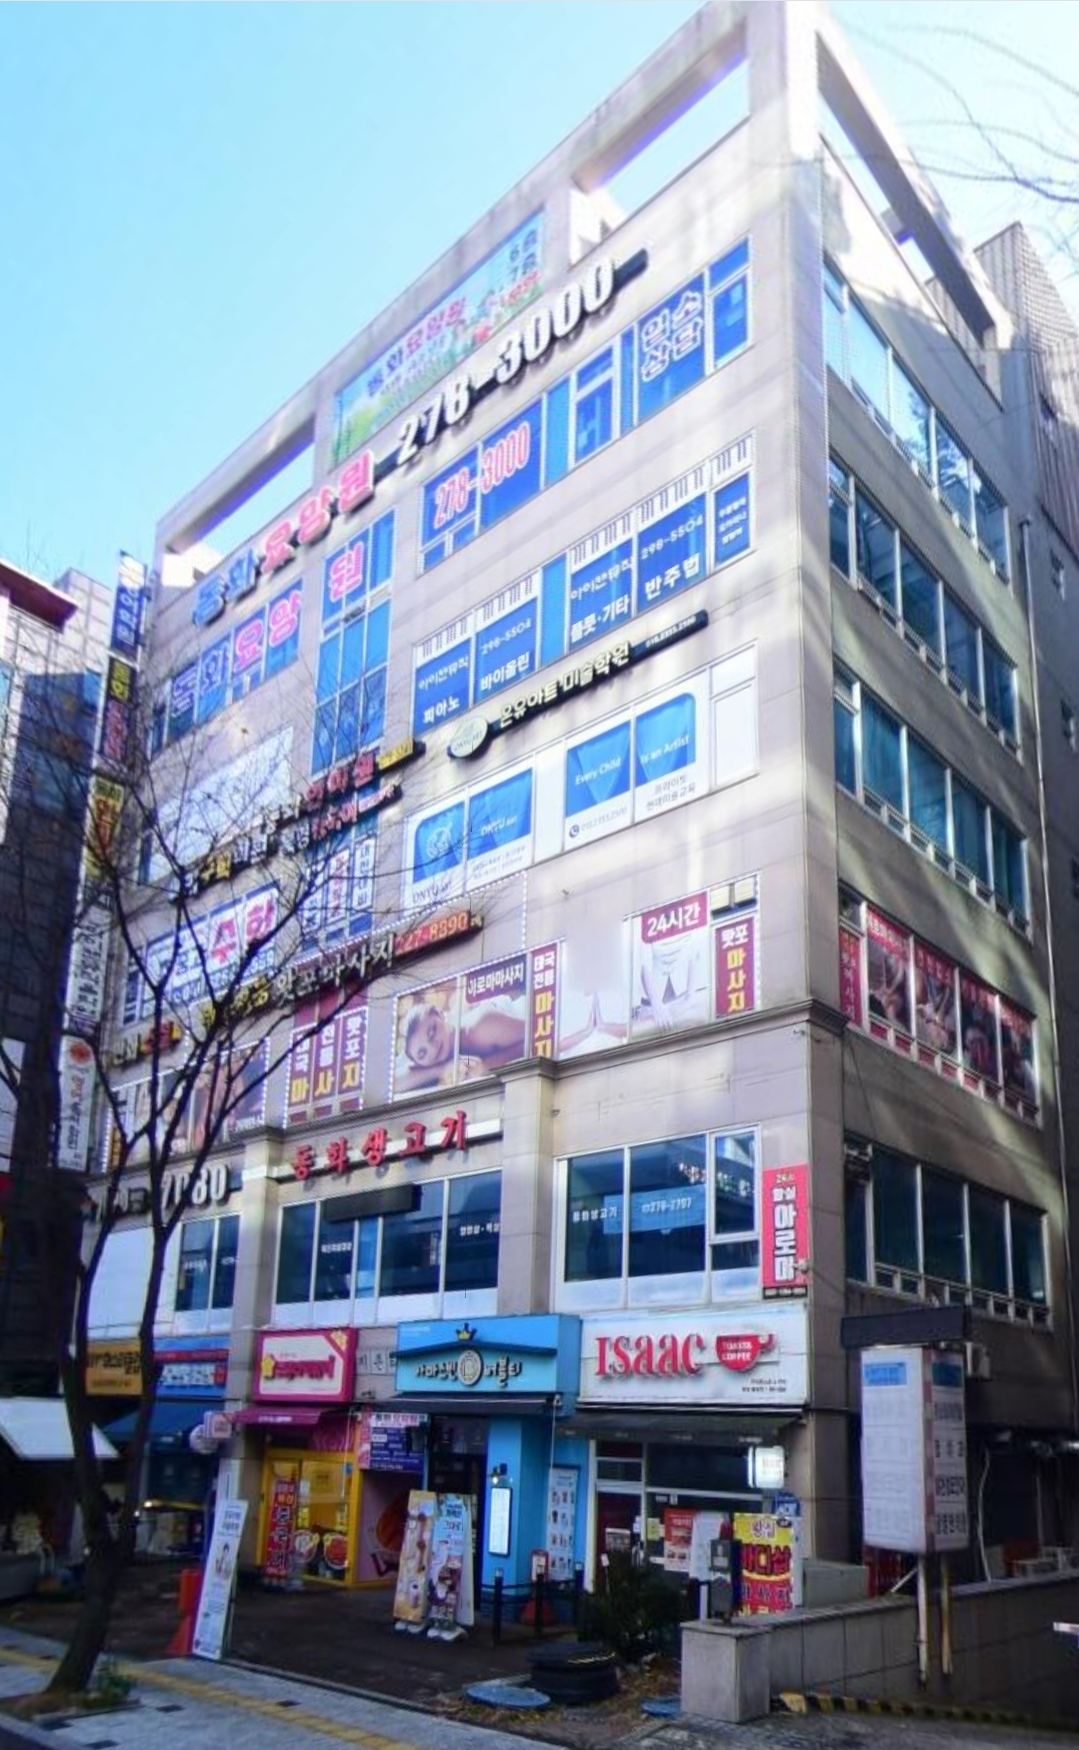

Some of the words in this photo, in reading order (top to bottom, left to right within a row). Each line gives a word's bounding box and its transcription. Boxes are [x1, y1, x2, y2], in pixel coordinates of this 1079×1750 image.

[434, 421, 530, 529] 278-3000
[645, 552, 700, 601] 반주법
[480, 651, 530, 691] 바이올린
[423, 694, 460, 724] 피아노
[645, 902, 703, 937] 24시간
[533, 969, 555, 990] 전통
[726, 948, 749, 1014] 마사지
[774, 1202, 798, 1282] 아로마
